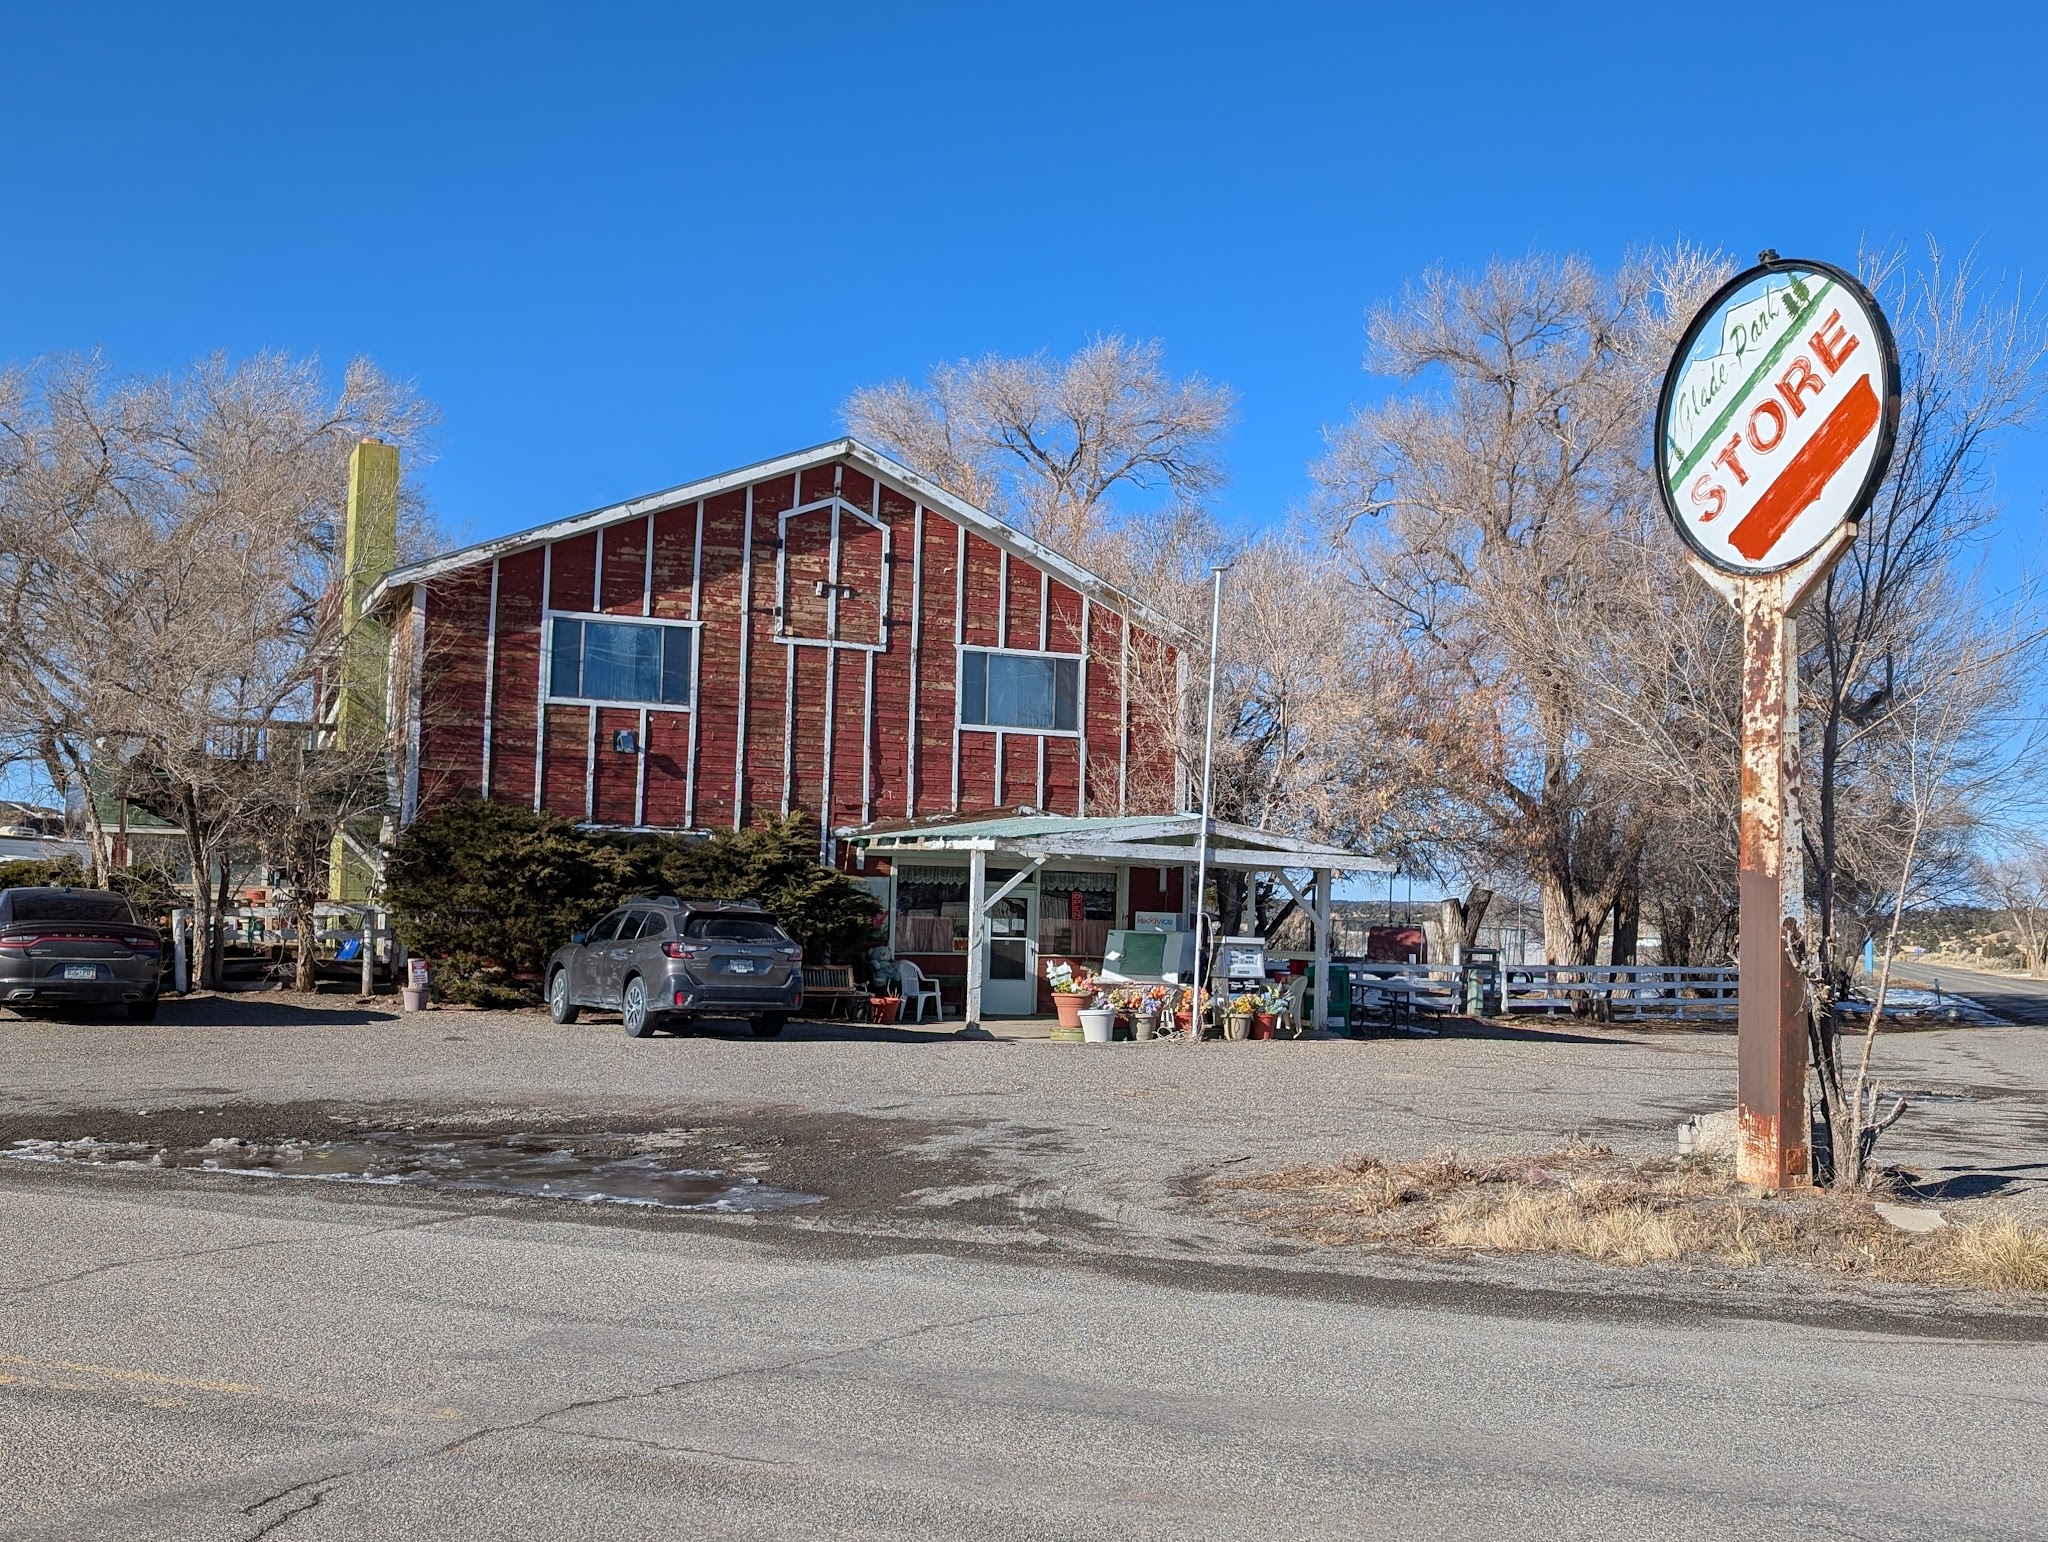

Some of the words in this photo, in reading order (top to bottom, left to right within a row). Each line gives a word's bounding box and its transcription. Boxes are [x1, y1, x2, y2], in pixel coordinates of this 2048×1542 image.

[1679, 361, 1728, 443] Glade
[1730, 285, 1779, 369] Park
[1691, 308, 1860, 525] STORE
[1073, 893, 1081, 918] OPEN
